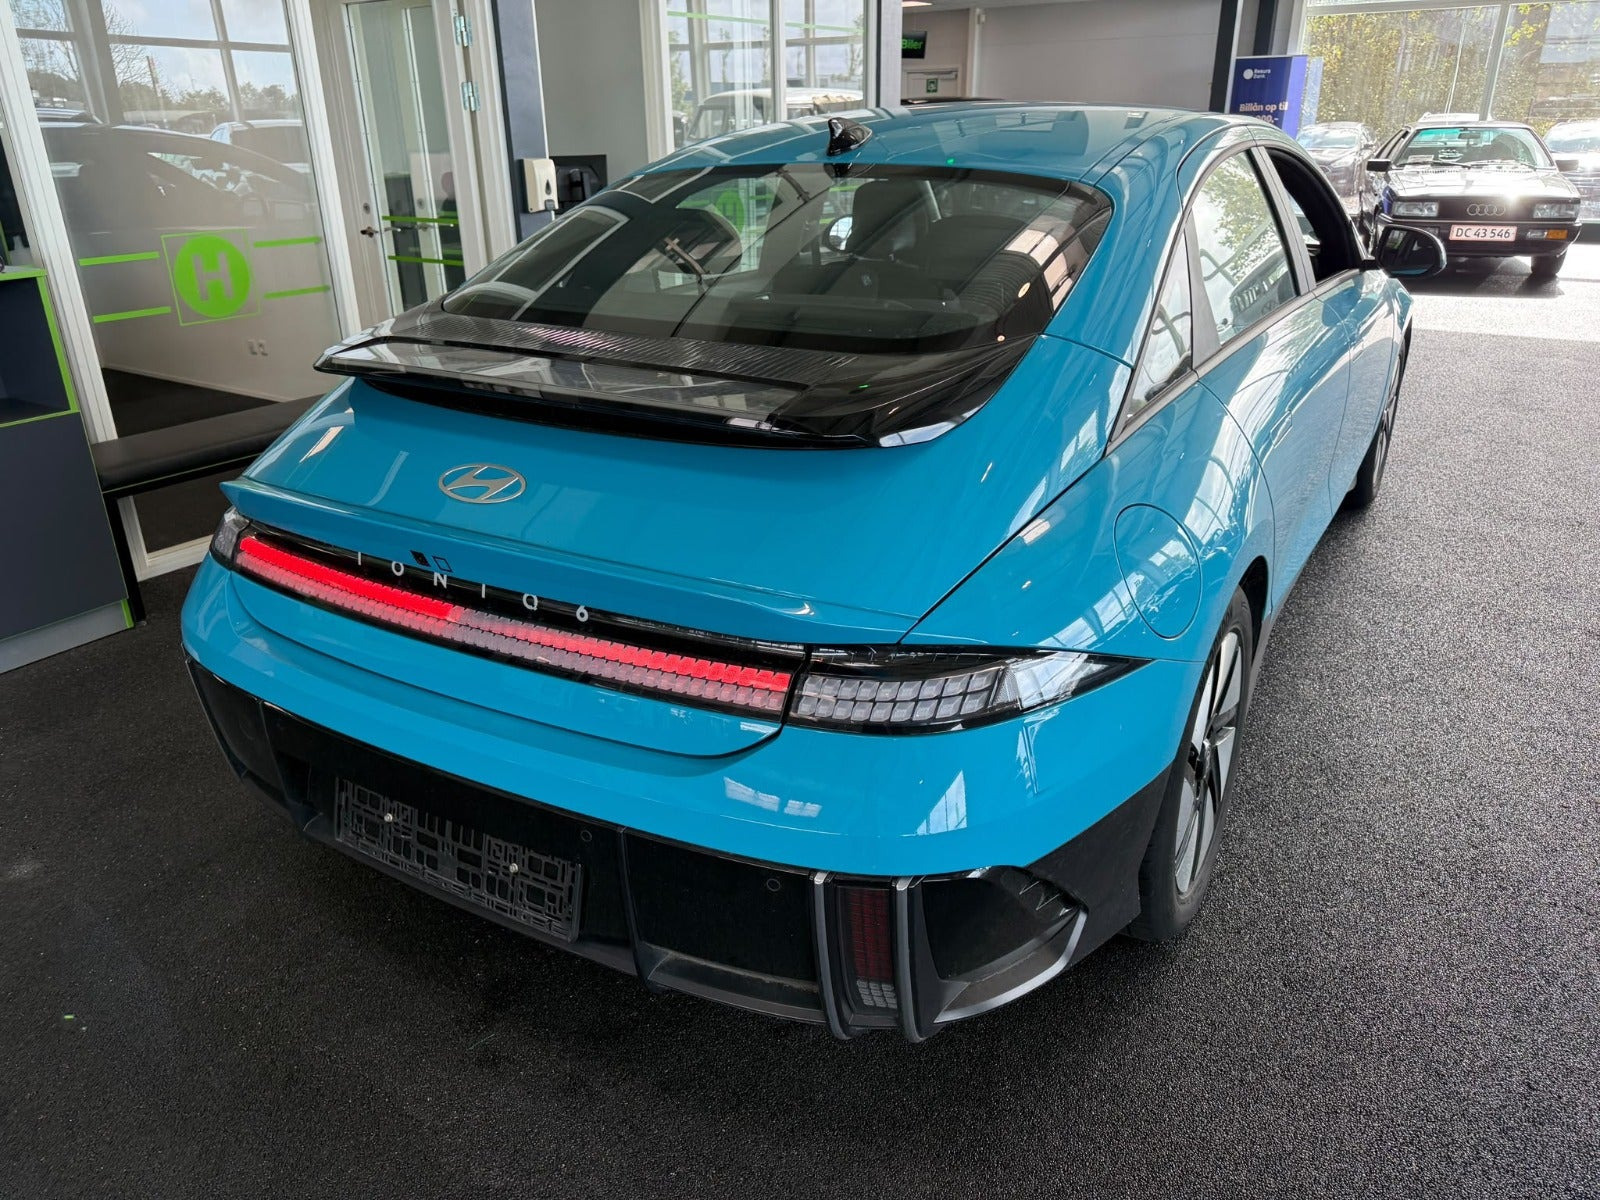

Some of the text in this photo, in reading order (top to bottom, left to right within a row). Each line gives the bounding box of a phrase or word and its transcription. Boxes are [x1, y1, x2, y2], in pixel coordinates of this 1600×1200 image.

[1239, 101, 1289, 113] Billån op til
[1455, 227, 1511, 239] DC 43 546
[192, 252, 233, 301] H
[357, 551, 589, 623] IONIQ 6
